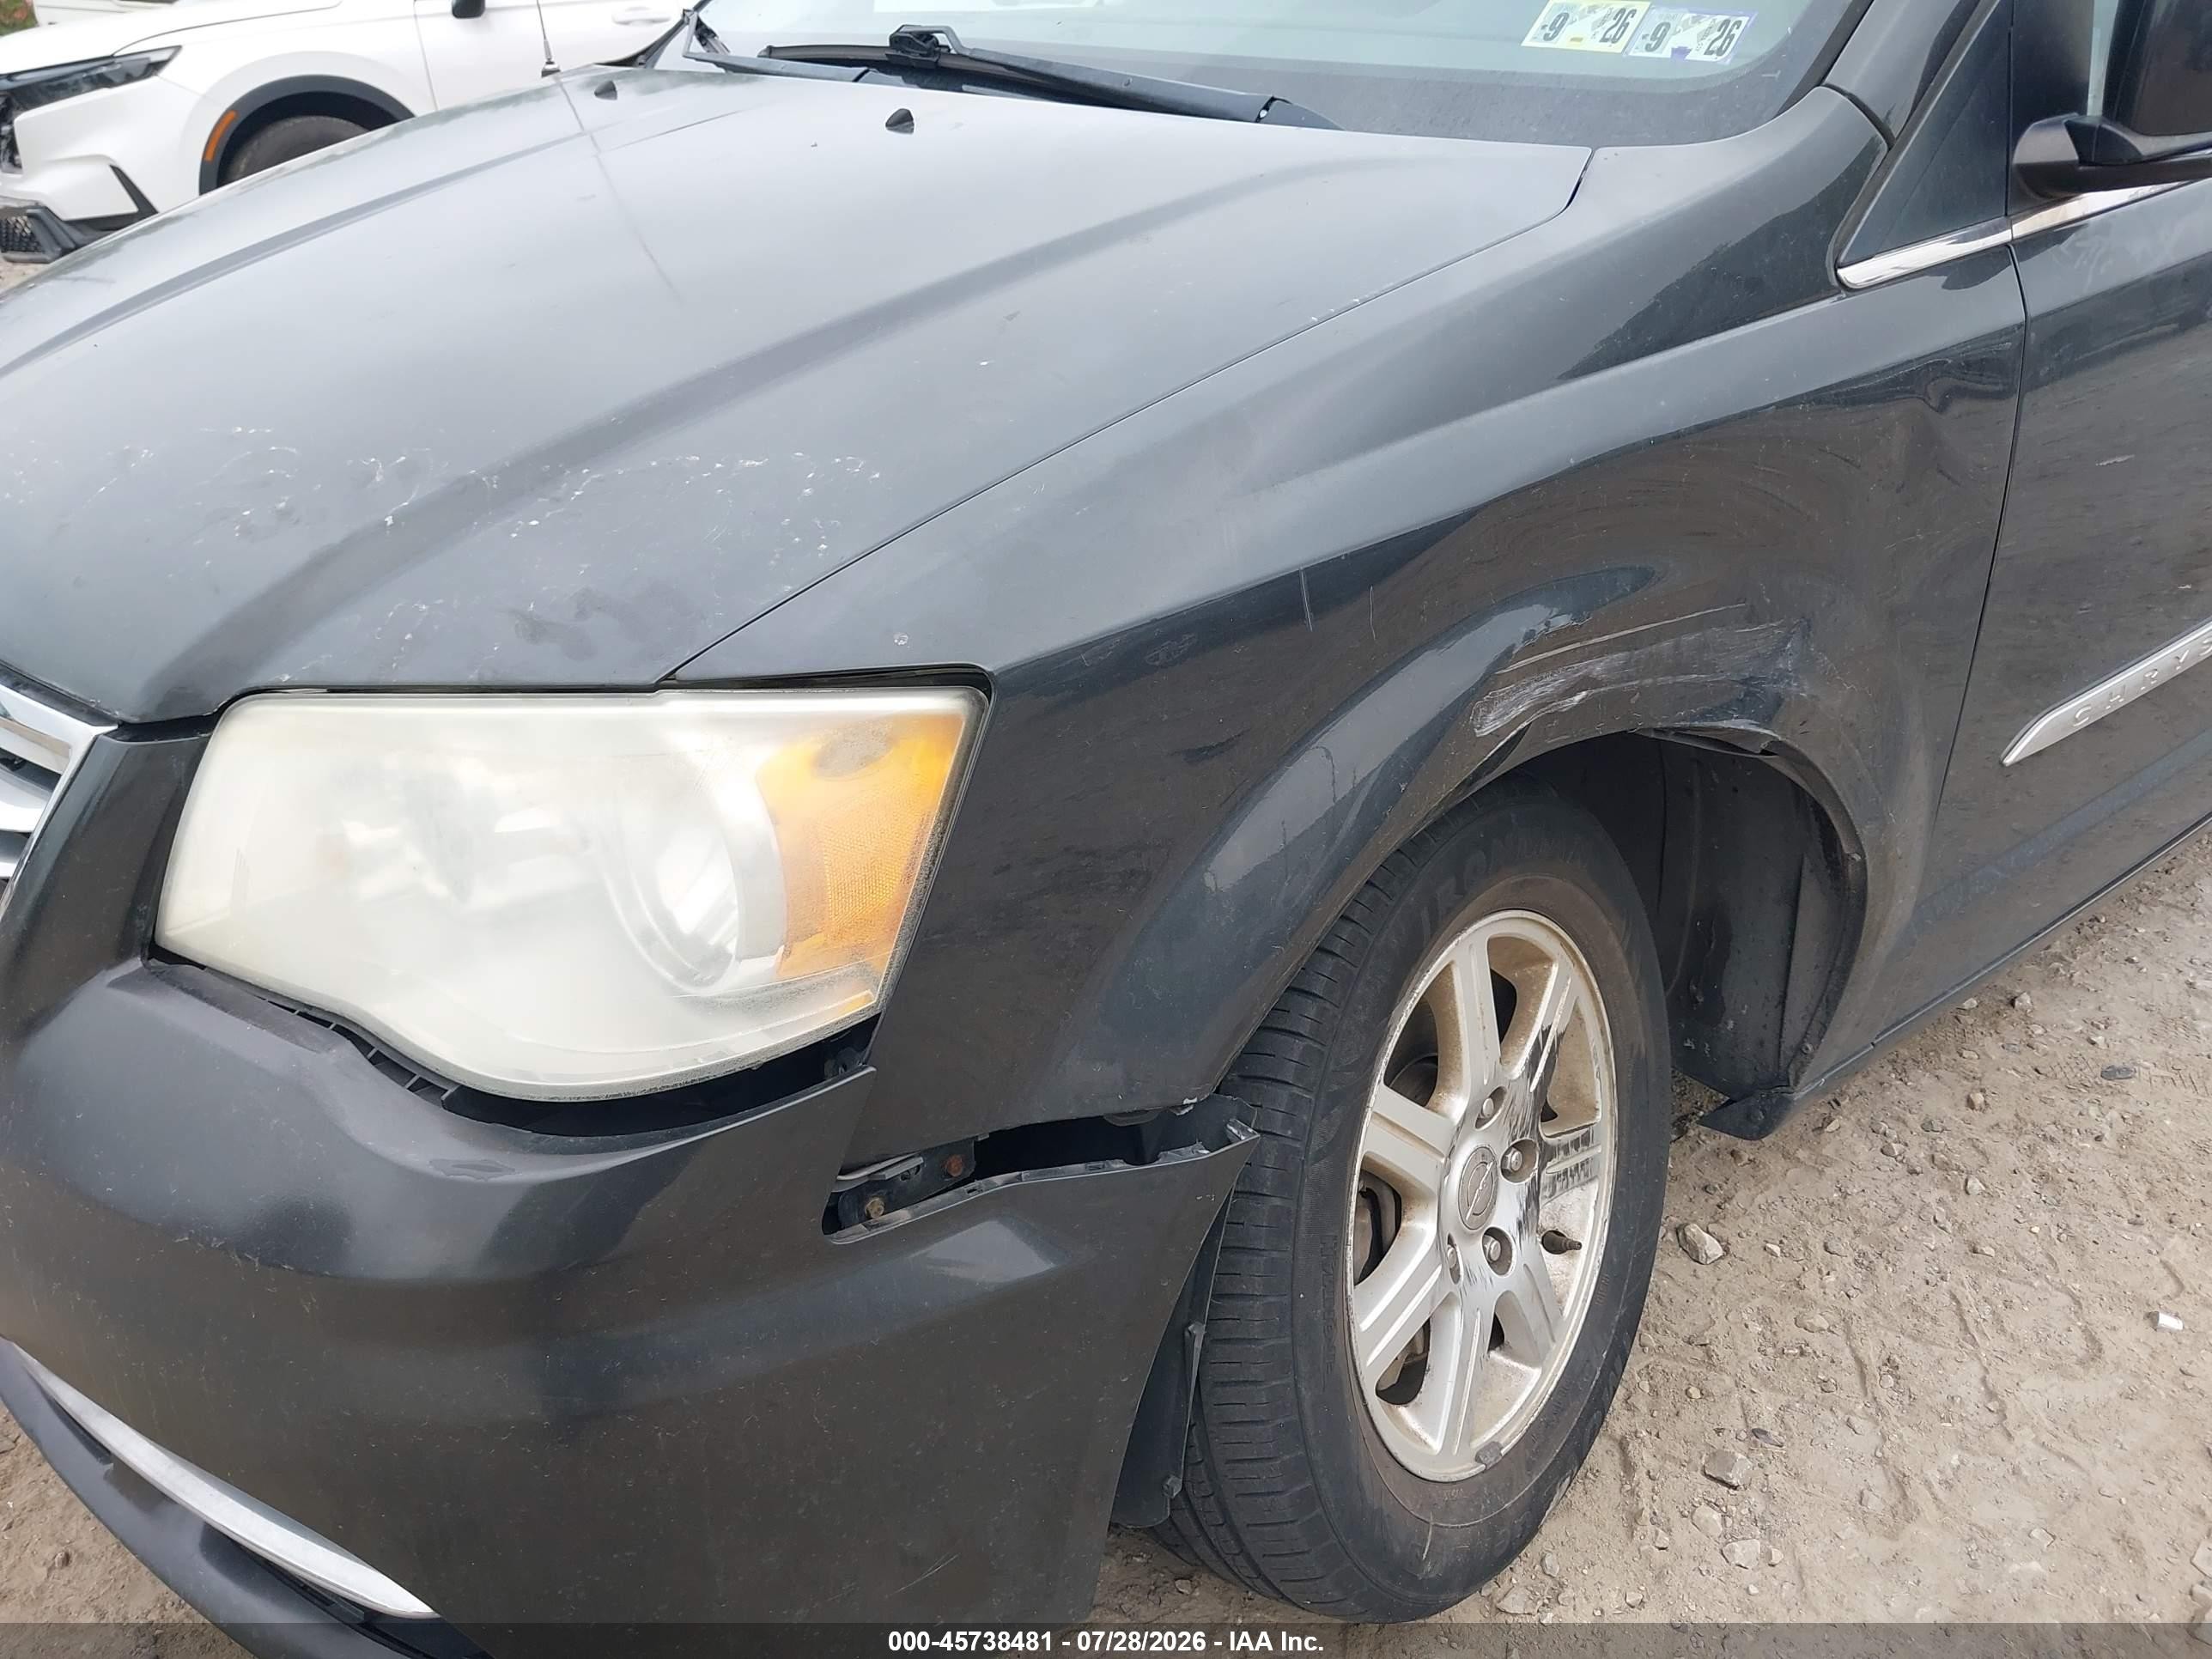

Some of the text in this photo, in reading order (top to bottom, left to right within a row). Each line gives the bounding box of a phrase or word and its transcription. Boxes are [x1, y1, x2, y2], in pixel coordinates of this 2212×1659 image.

[1543, 12, 1570, 42] 9
[1599, 8, 1638, 44] 26
[1644, 21, 1671, 52] 9
[1704, 19, 1742, 57] 26
